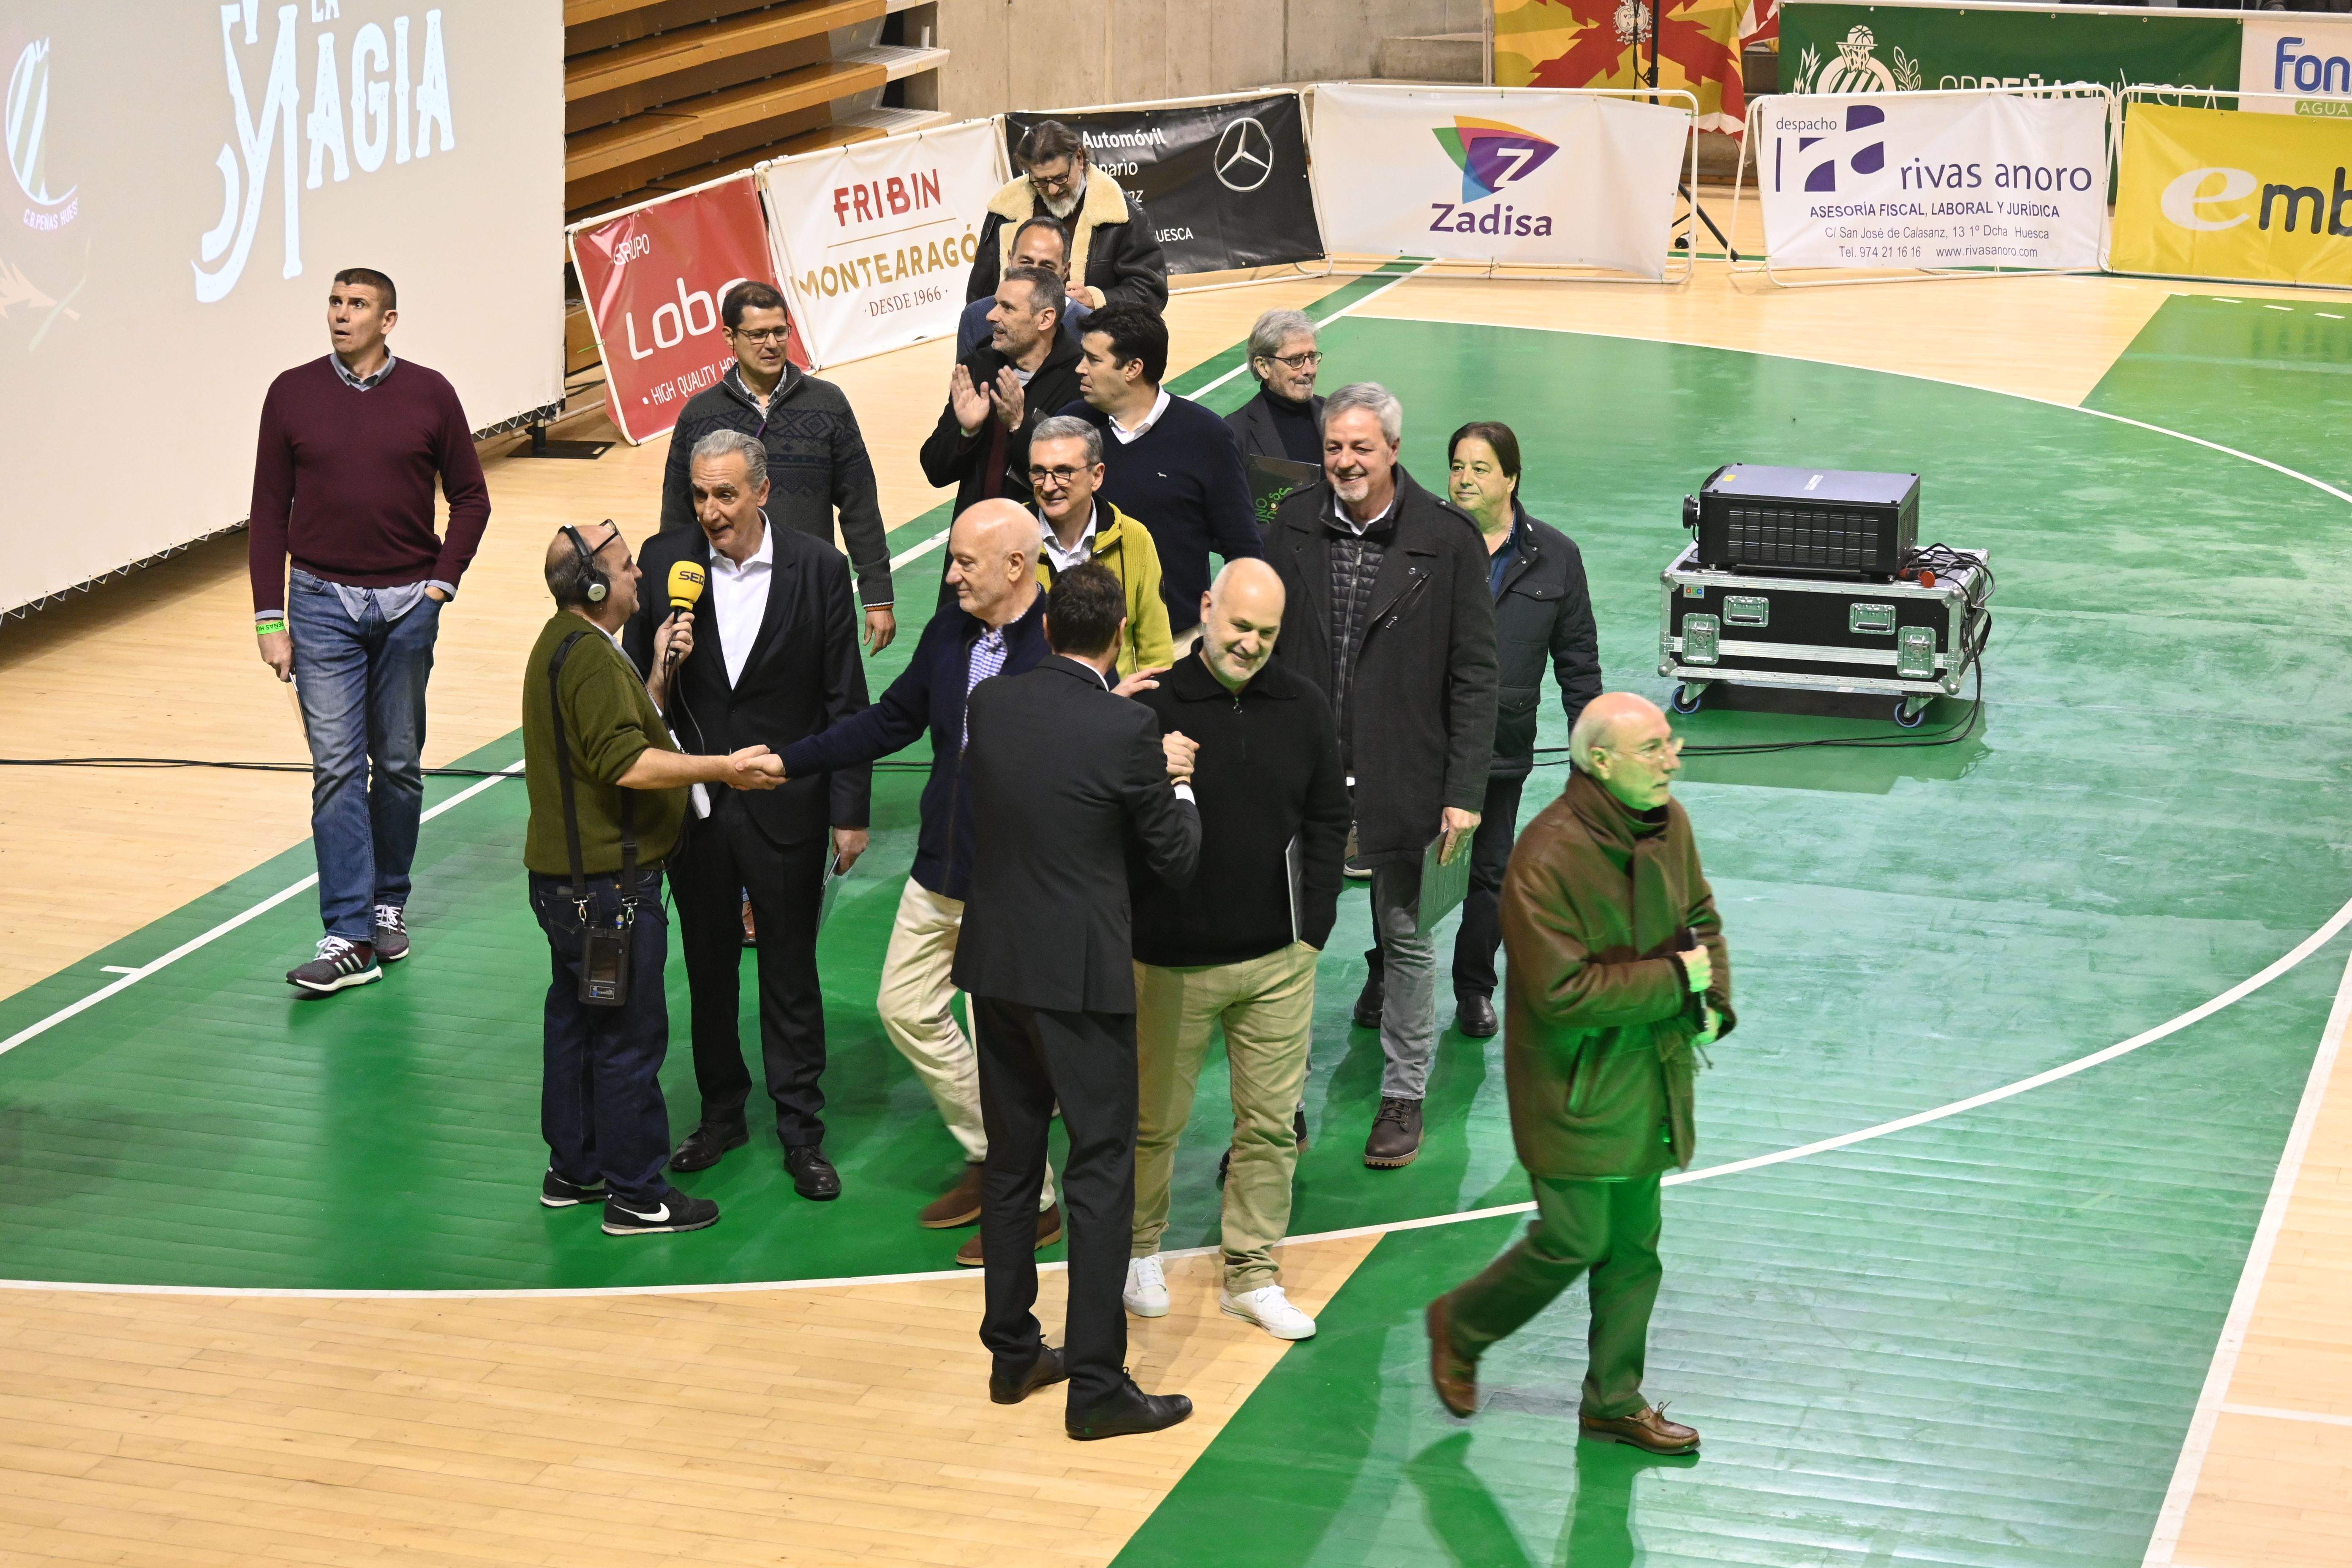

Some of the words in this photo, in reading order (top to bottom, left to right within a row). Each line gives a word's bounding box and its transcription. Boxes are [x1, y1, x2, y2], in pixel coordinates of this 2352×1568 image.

[2298, 102, 2349, 115] AGUA
[1082, 128, 1167, 149] Automóvil
[1775, 117, 1838, 133] despacho
[191, 4, 455, 303] MAGIA
[1900, 157, 1982, 190] rivas
[1995, 162, 2092, 192] anoro
[833, 169, 941, 227] FRIBIN
[1810, 201, 1876, 218] ASESORÍA
[1879, 203, 1927, 218] FISCAL,
[1931, 201, 1993, 215] LABORAL
[1997, 201, 2004, 214] Y
[2006, 201, 2060, 218] JURÍDICA
[2160, 166, 2352, 237] emb
[1429, 203, 1552, 237] Zadisa
[1825, 227, 1836, 238] C/
[1840, 226, 1858, 238] San
[1860, 227, 1884, 239] José
[1887, 228, 1900, 239] de
[1903, 226, 1948, 240] Calasanz,
[1952, 226, 1965, 237] 13
[1983, 225, 2008, 237] Dcha
[2014, 226, 2049, 239] Huesca
[613, 233, 650, 266] GRUPO
[1839, 246, 1857, 258] Tel.
[1859, 246, 1878, 258] 974
[1882, 246, 1892, 257] 21
[1897, 246, 1907, 258] 16
[1911, 246, 1921, 258] 16
[1936, 245, 2038, 258] www.rivasanoro.com
[869, 291, 912, 317] DESDE
[914, 286, 942, 306] 1966
[651, 381, 677, 406] HIGH
[677, 363, 717, 398] QUALITY
